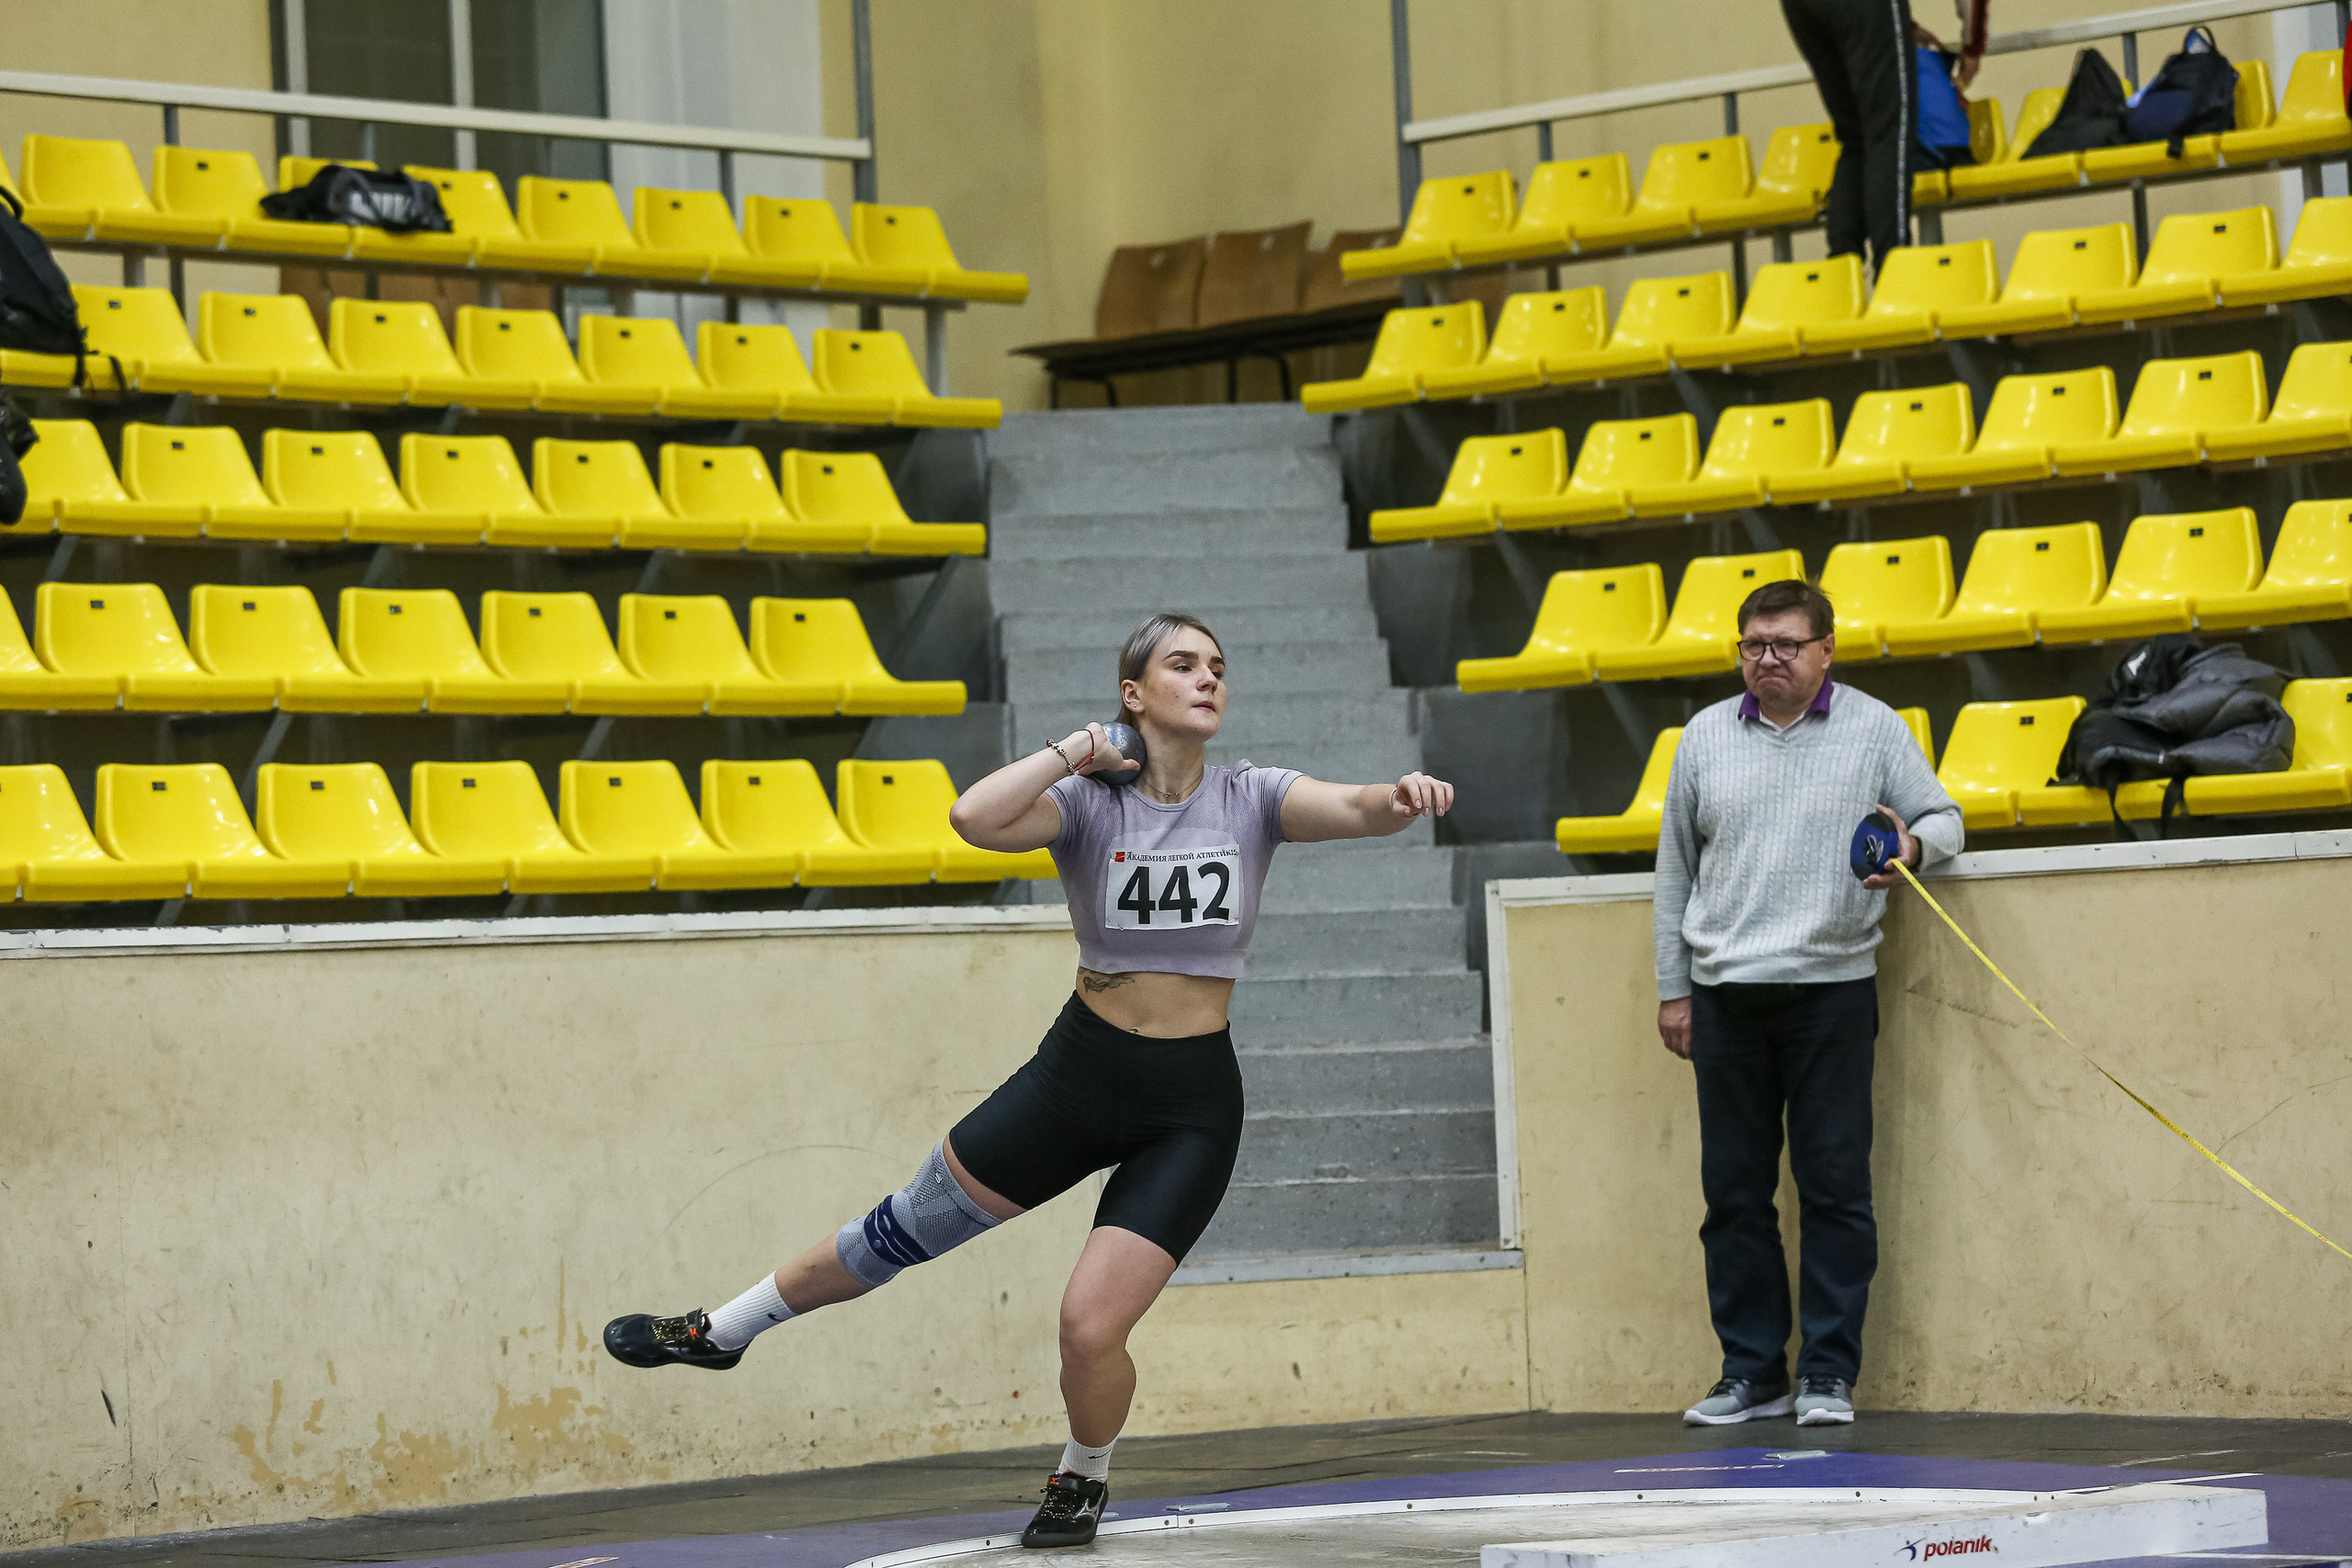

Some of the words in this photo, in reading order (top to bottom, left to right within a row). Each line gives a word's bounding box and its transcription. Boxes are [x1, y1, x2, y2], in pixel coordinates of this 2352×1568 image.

[1126, 851, 1167, 863] АКАДЕМИЯ
[1168, 852, 1195, 863] ЛЕГКОЙ
[1117, 861, 1230, 925] 442
[1923, 1534, 1993, 1562] polanik
